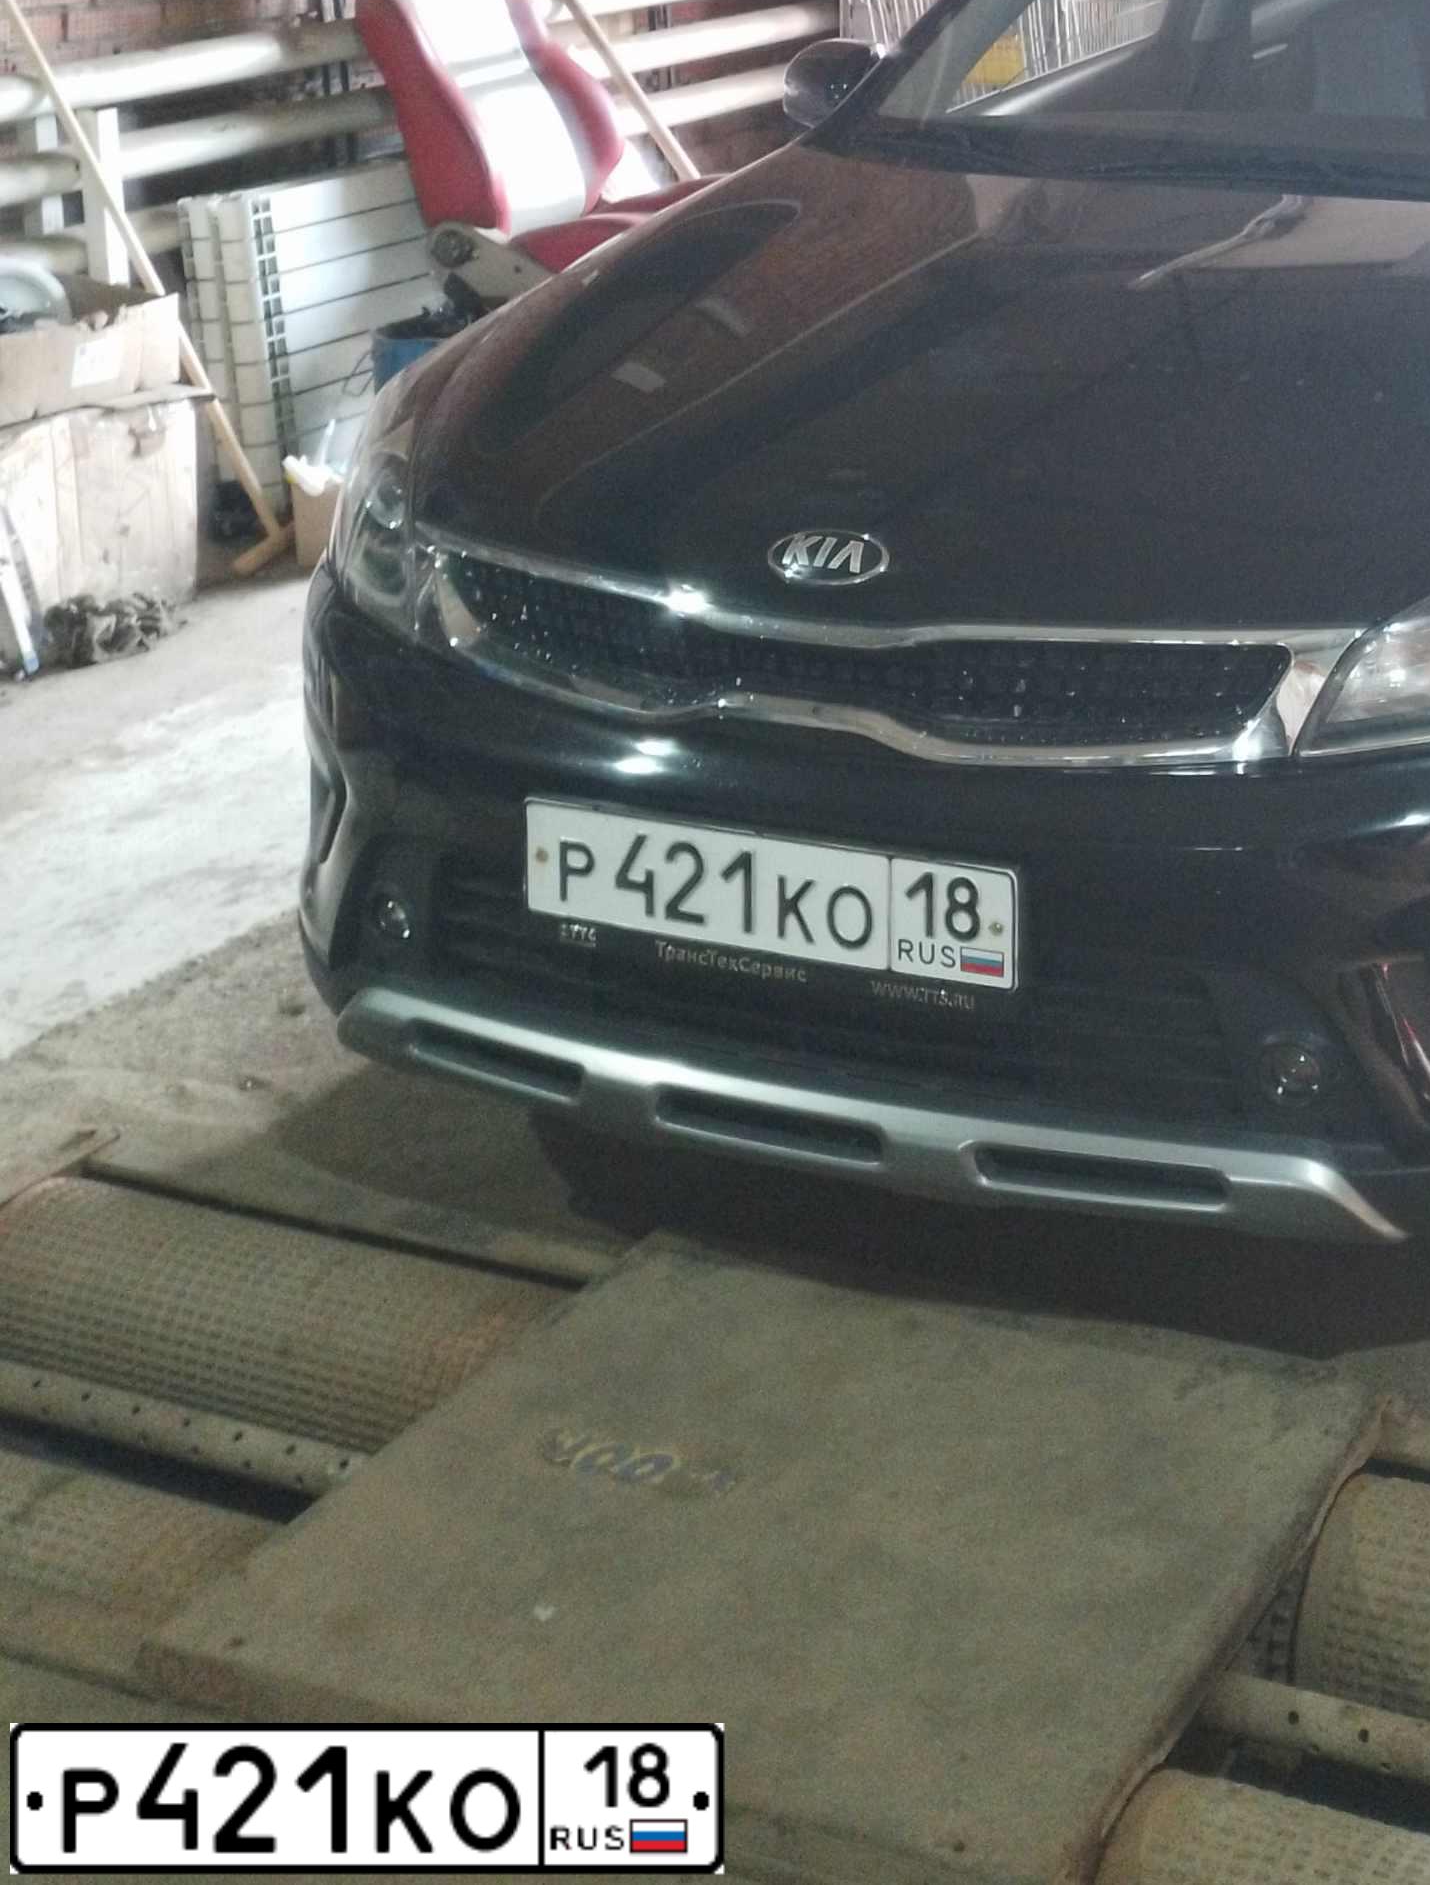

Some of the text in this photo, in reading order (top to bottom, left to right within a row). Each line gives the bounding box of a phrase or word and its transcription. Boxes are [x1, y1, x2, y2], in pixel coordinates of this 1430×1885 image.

[781, 534, 865, 574] KIA
[904, 871, 982, 942] 18
[897, 937, 957, 969] RUS
